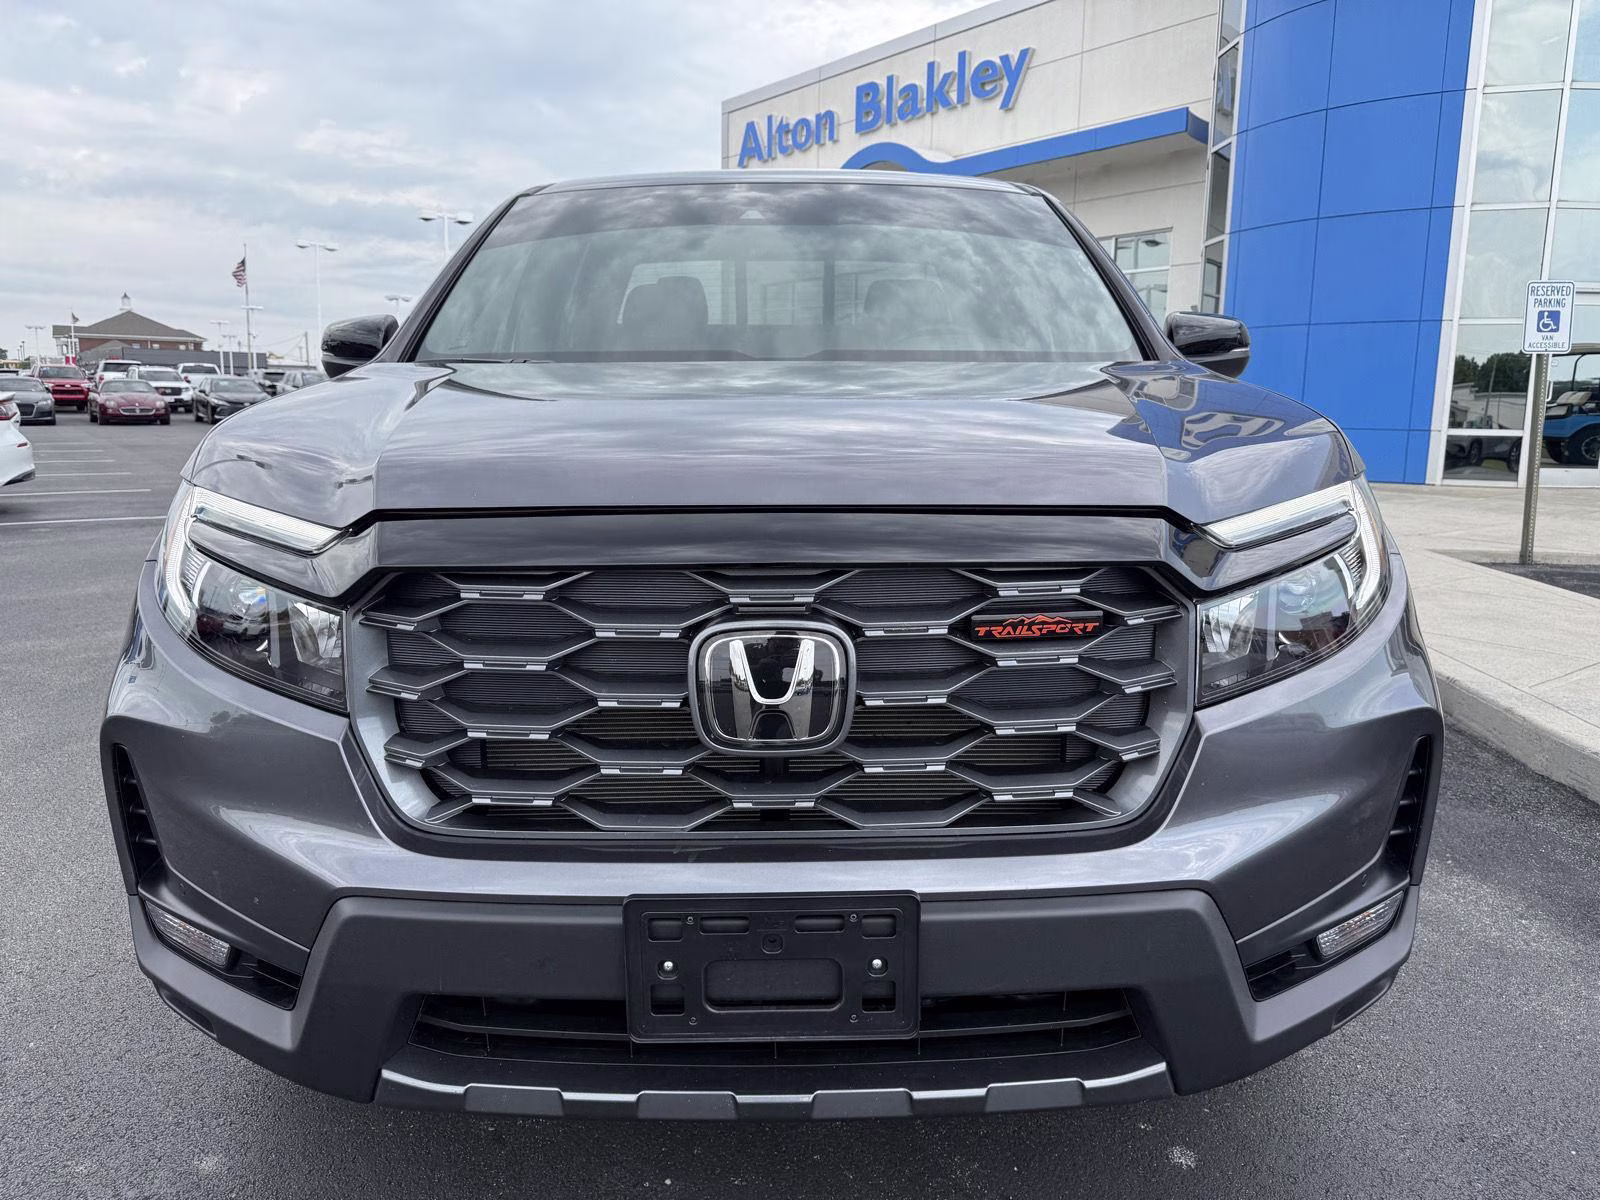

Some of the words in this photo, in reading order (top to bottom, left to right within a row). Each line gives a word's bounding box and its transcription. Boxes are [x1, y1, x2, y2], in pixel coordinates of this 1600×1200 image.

[738, 109, 840, 168] Alton
[854, 46, 1036, 135] Blakley
[1530, 285, 1571, 297] RESERVED
[1533, 297, 1567, 309] PARKING
[1527, 341, 1566, 349] ACCESSIBLE
[975, 622, 1100, 638] TRAILSPORT
